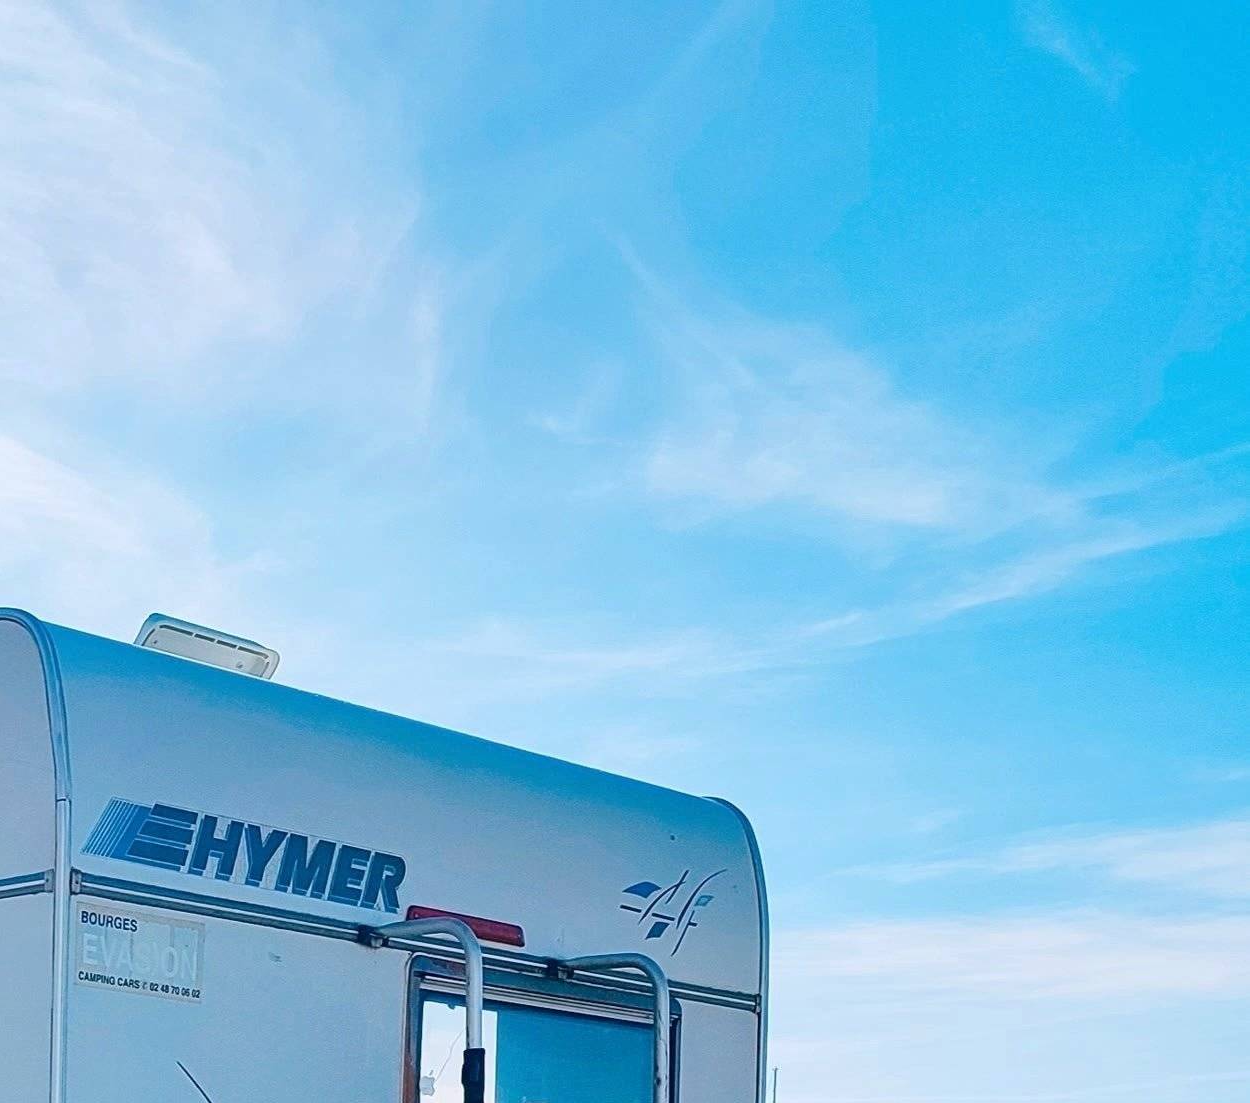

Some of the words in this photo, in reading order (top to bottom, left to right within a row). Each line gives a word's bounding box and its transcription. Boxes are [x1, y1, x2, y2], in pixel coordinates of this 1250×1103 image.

[188, 813, 407, 915] HYMER
[81, 911, 138, 932] BOURGES
[78, 971, 115, 986] CAMPING
[117, 977, 140, 989] CARS
[149, 982, 159, 992] 02
[161, 984, 170, 994] 48
[171, 985, 180, 996] 70
